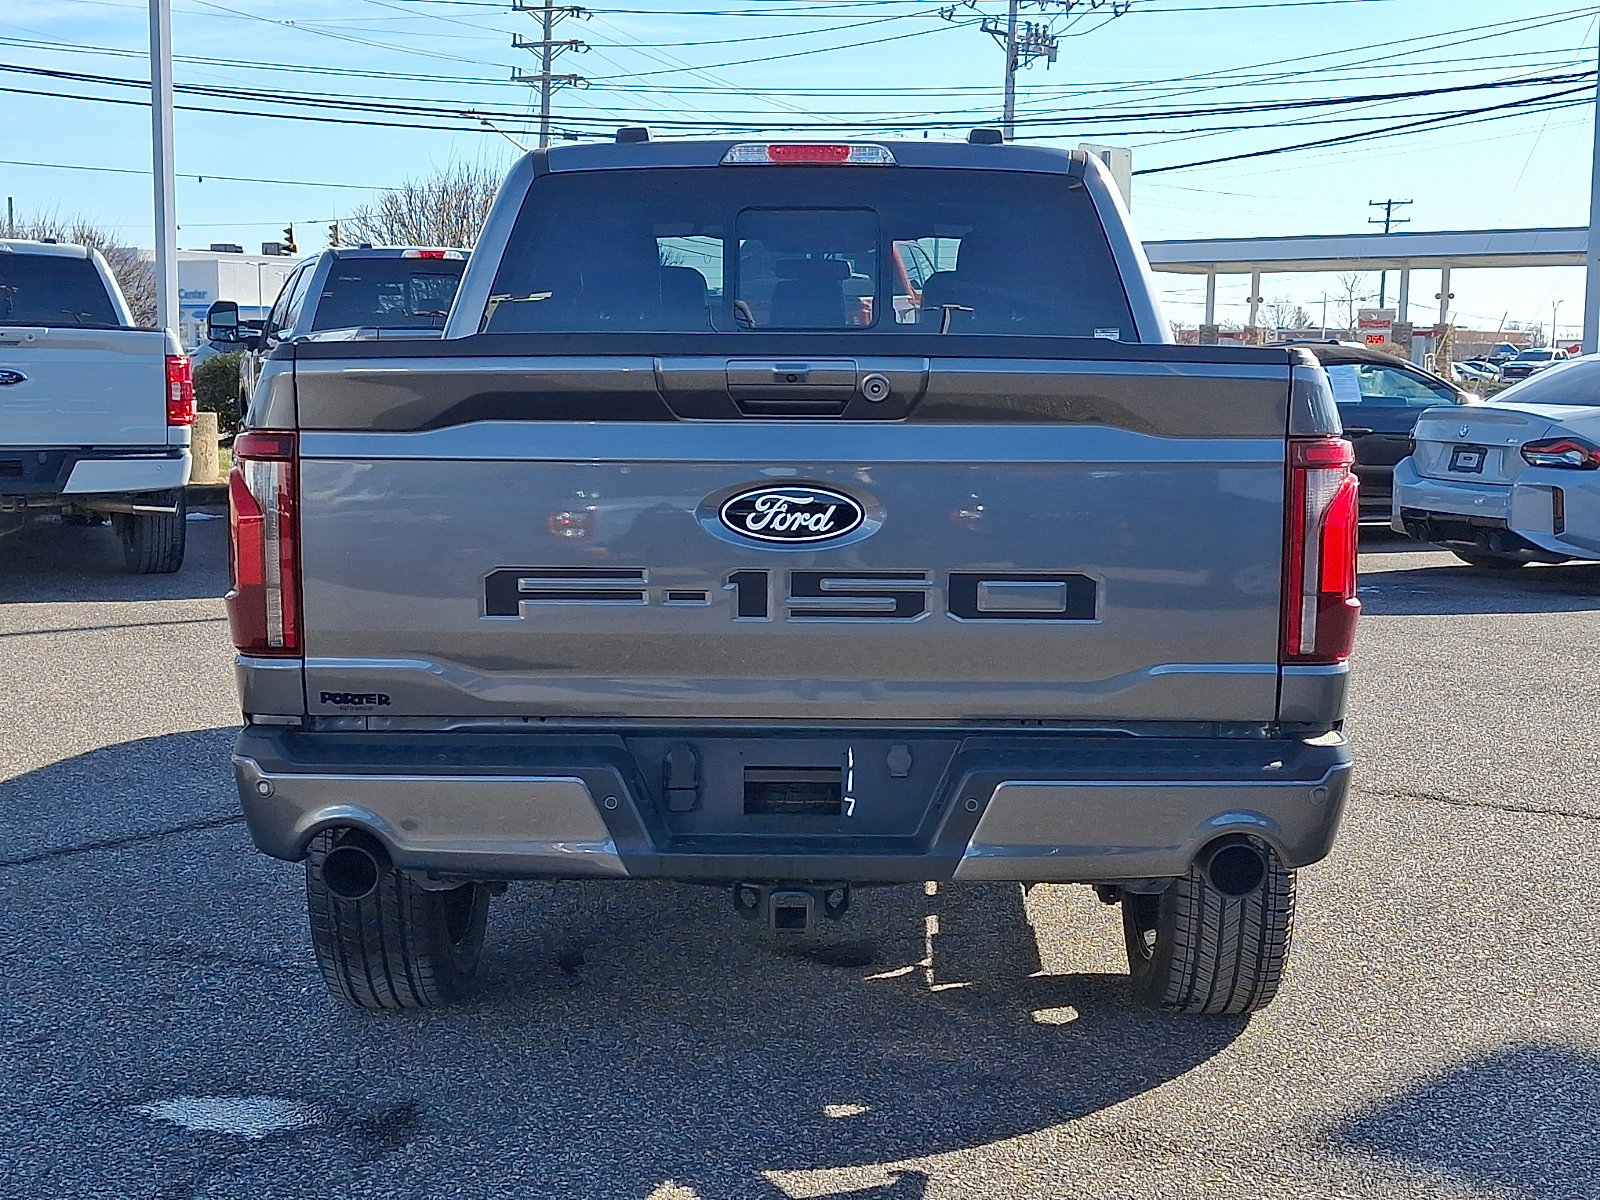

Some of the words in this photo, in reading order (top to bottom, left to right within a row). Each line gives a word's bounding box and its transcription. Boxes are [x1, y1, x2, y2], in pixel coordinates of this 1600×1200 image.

[745, 494, 837, 532] Ford
[480, 566, 1103, 624] F-150
[319, 691, 392, 707] PORTER
